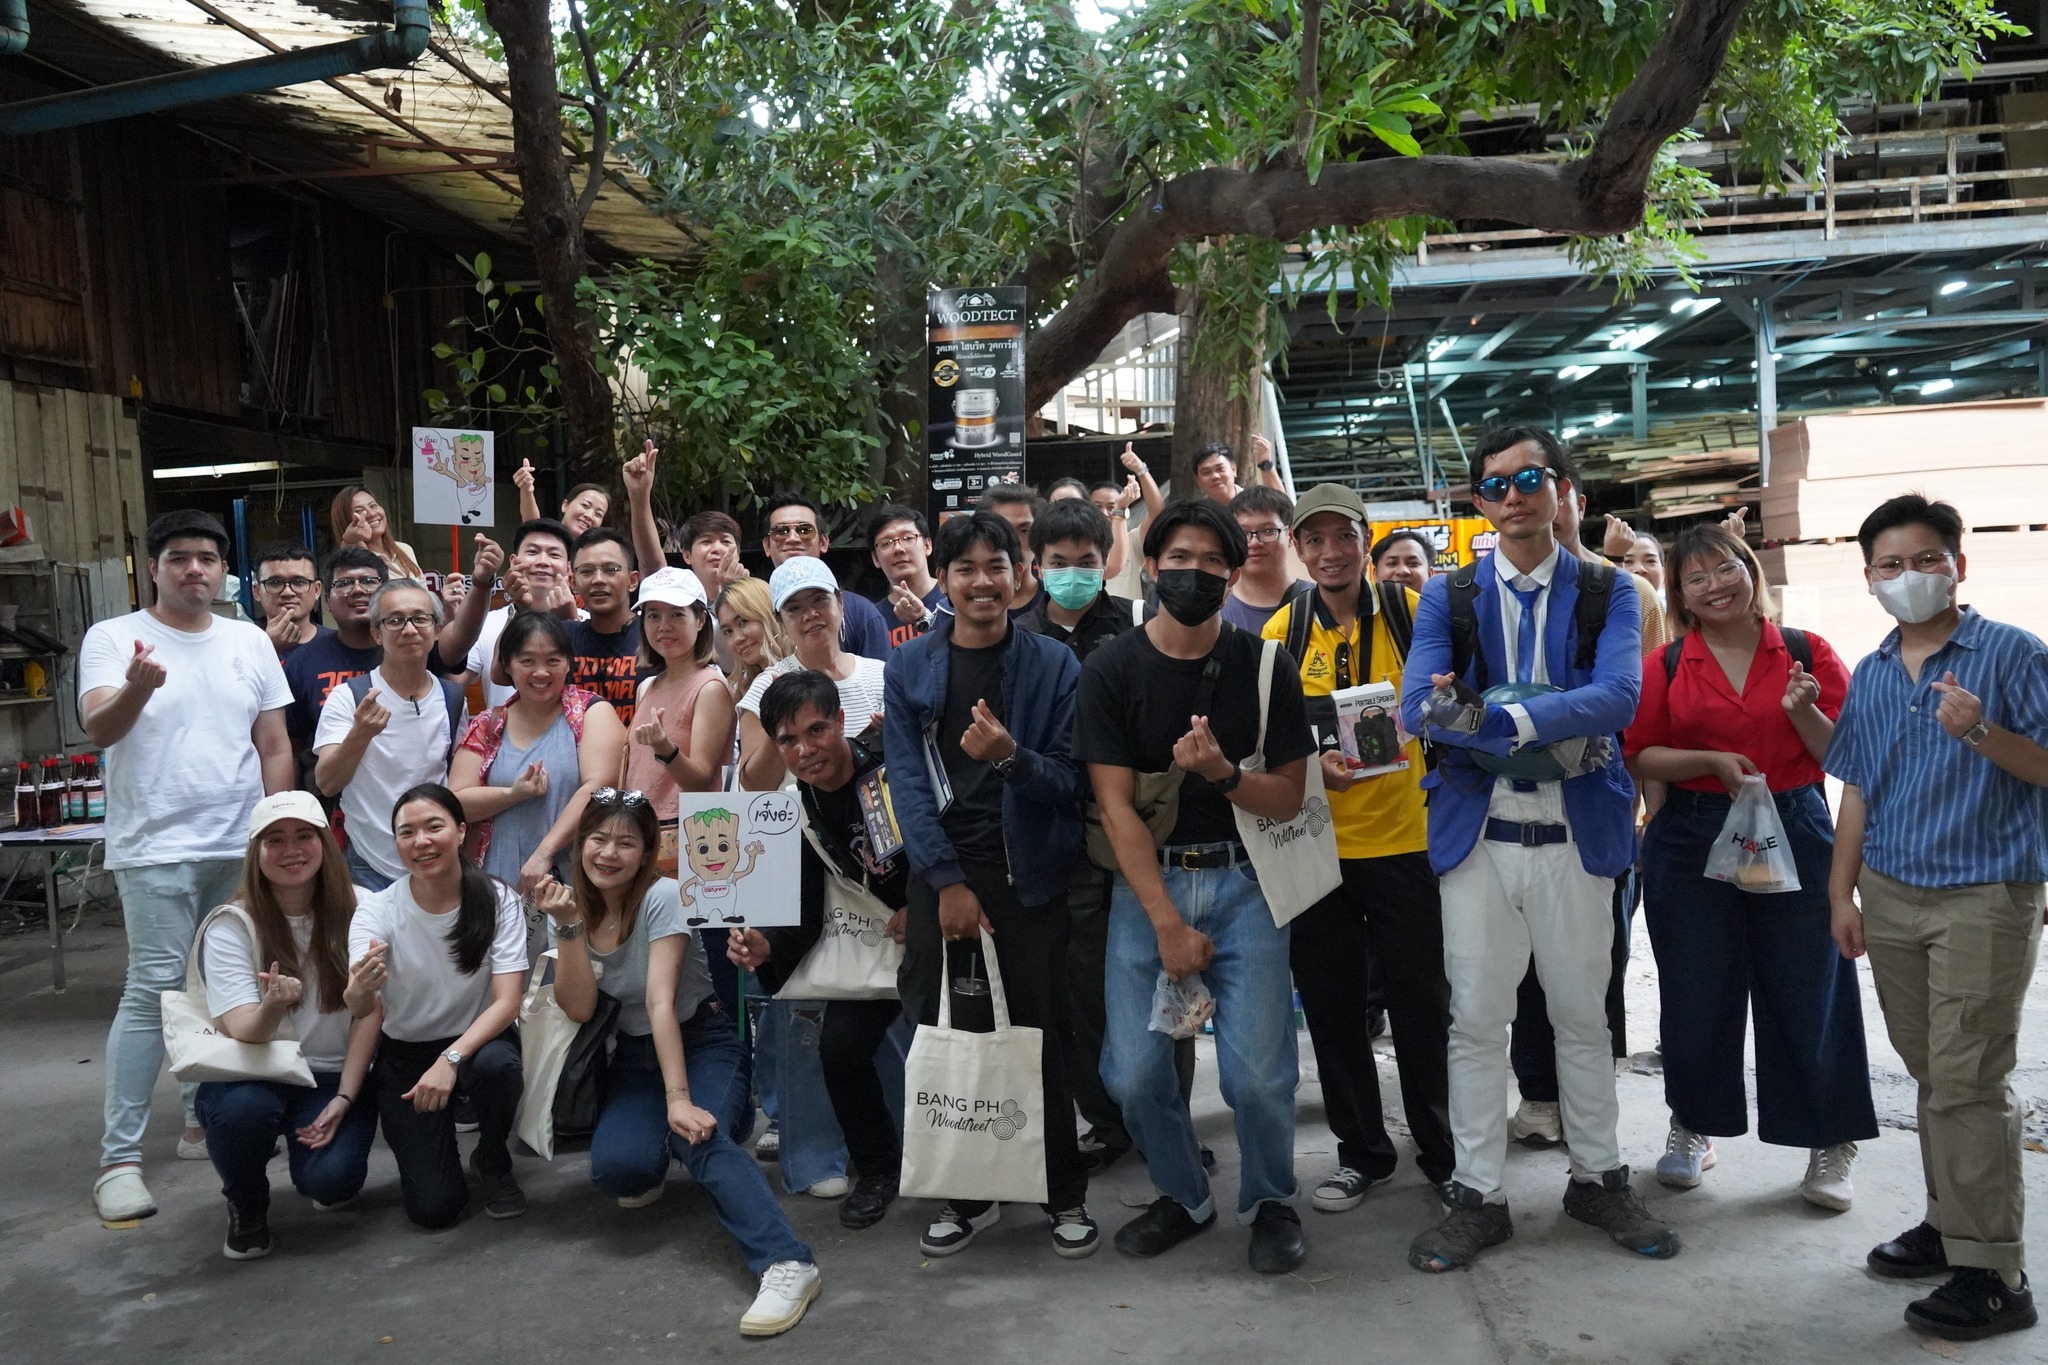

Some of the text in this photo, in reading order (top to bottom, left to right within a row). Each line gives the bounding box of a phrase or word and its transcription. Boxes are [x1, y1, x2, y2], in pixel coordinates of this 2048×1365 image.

[937, 309, 1017, 324] WOODTECT
[974, 452, 991, 460] Hybrid
[917, 1092, 967, 1112] BANG
[925, 1108, 996, 1132] Woodstreet
